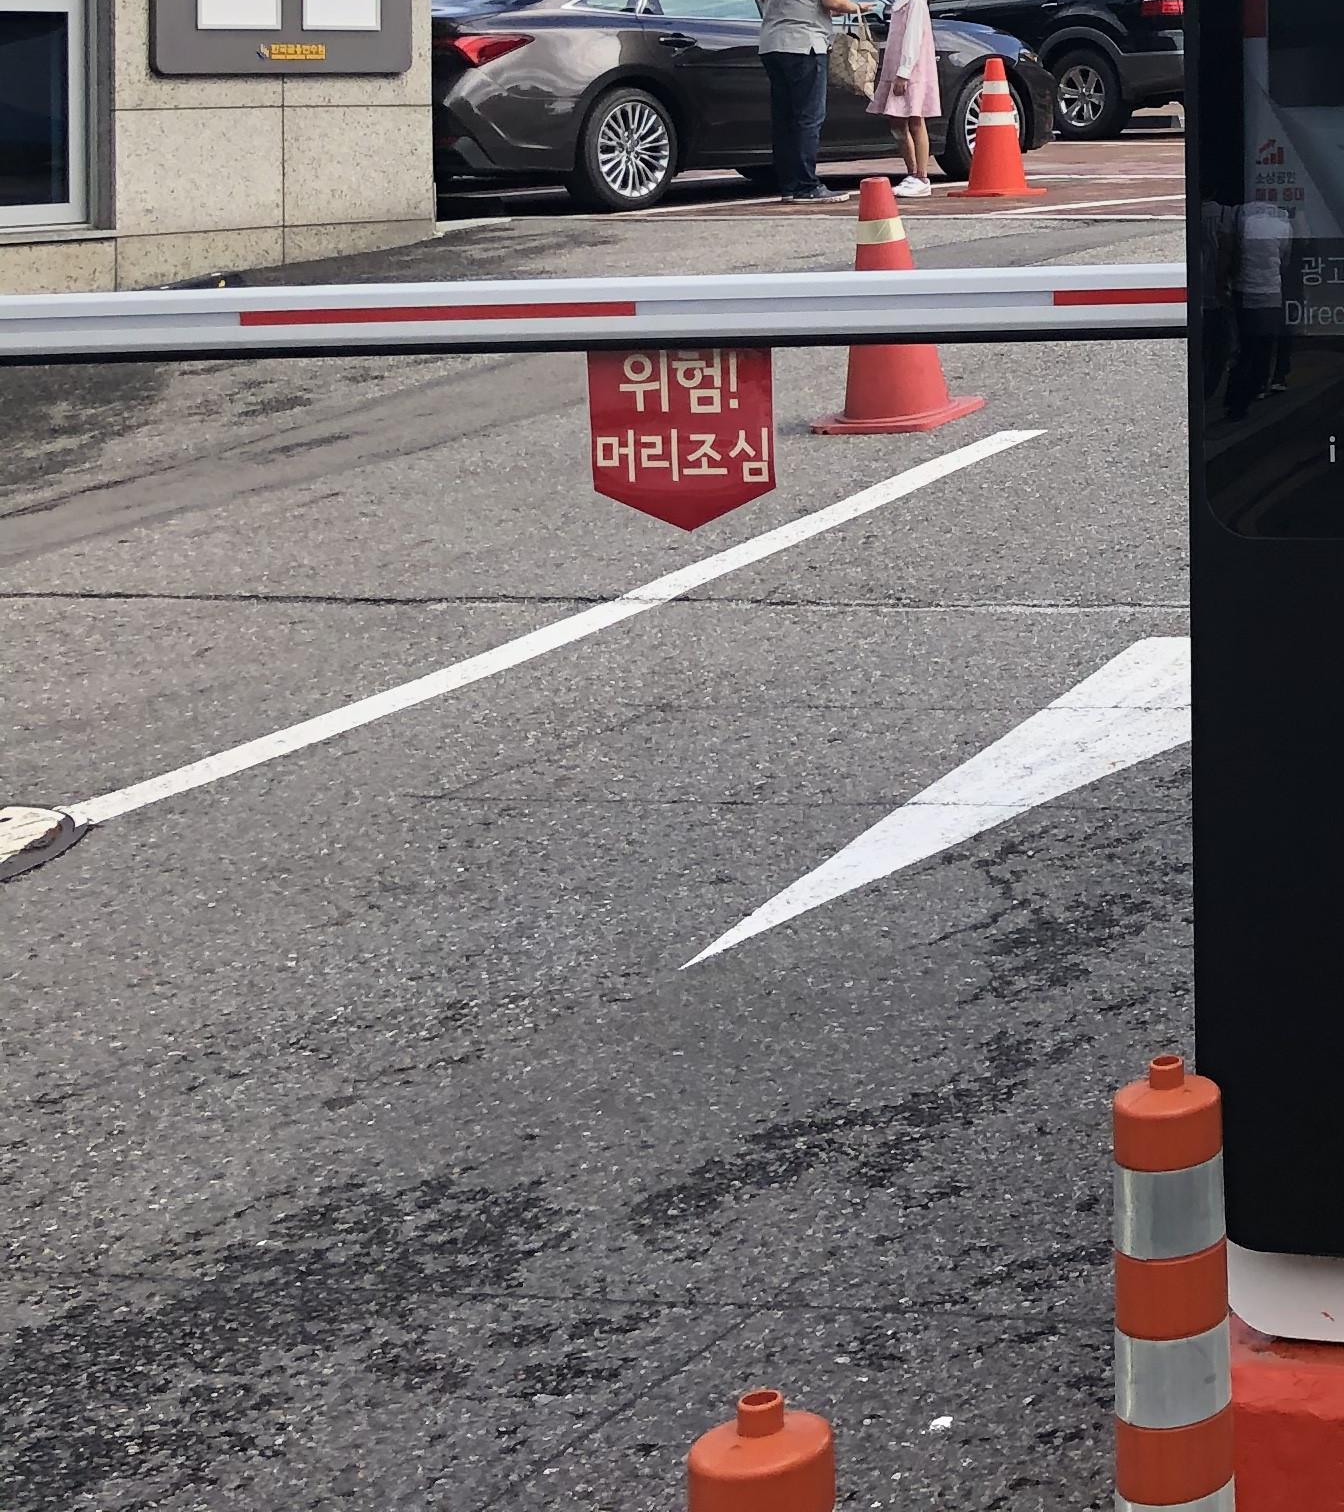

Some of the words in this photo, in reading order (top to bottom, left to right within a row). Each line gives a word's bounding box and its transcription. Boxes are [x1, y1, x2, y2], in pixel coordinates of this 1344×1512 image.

[620, 348, 739, 414] 위험!
[597, 427, 769, 483] 머리조심
[1329, 436, 1336, 463] i
